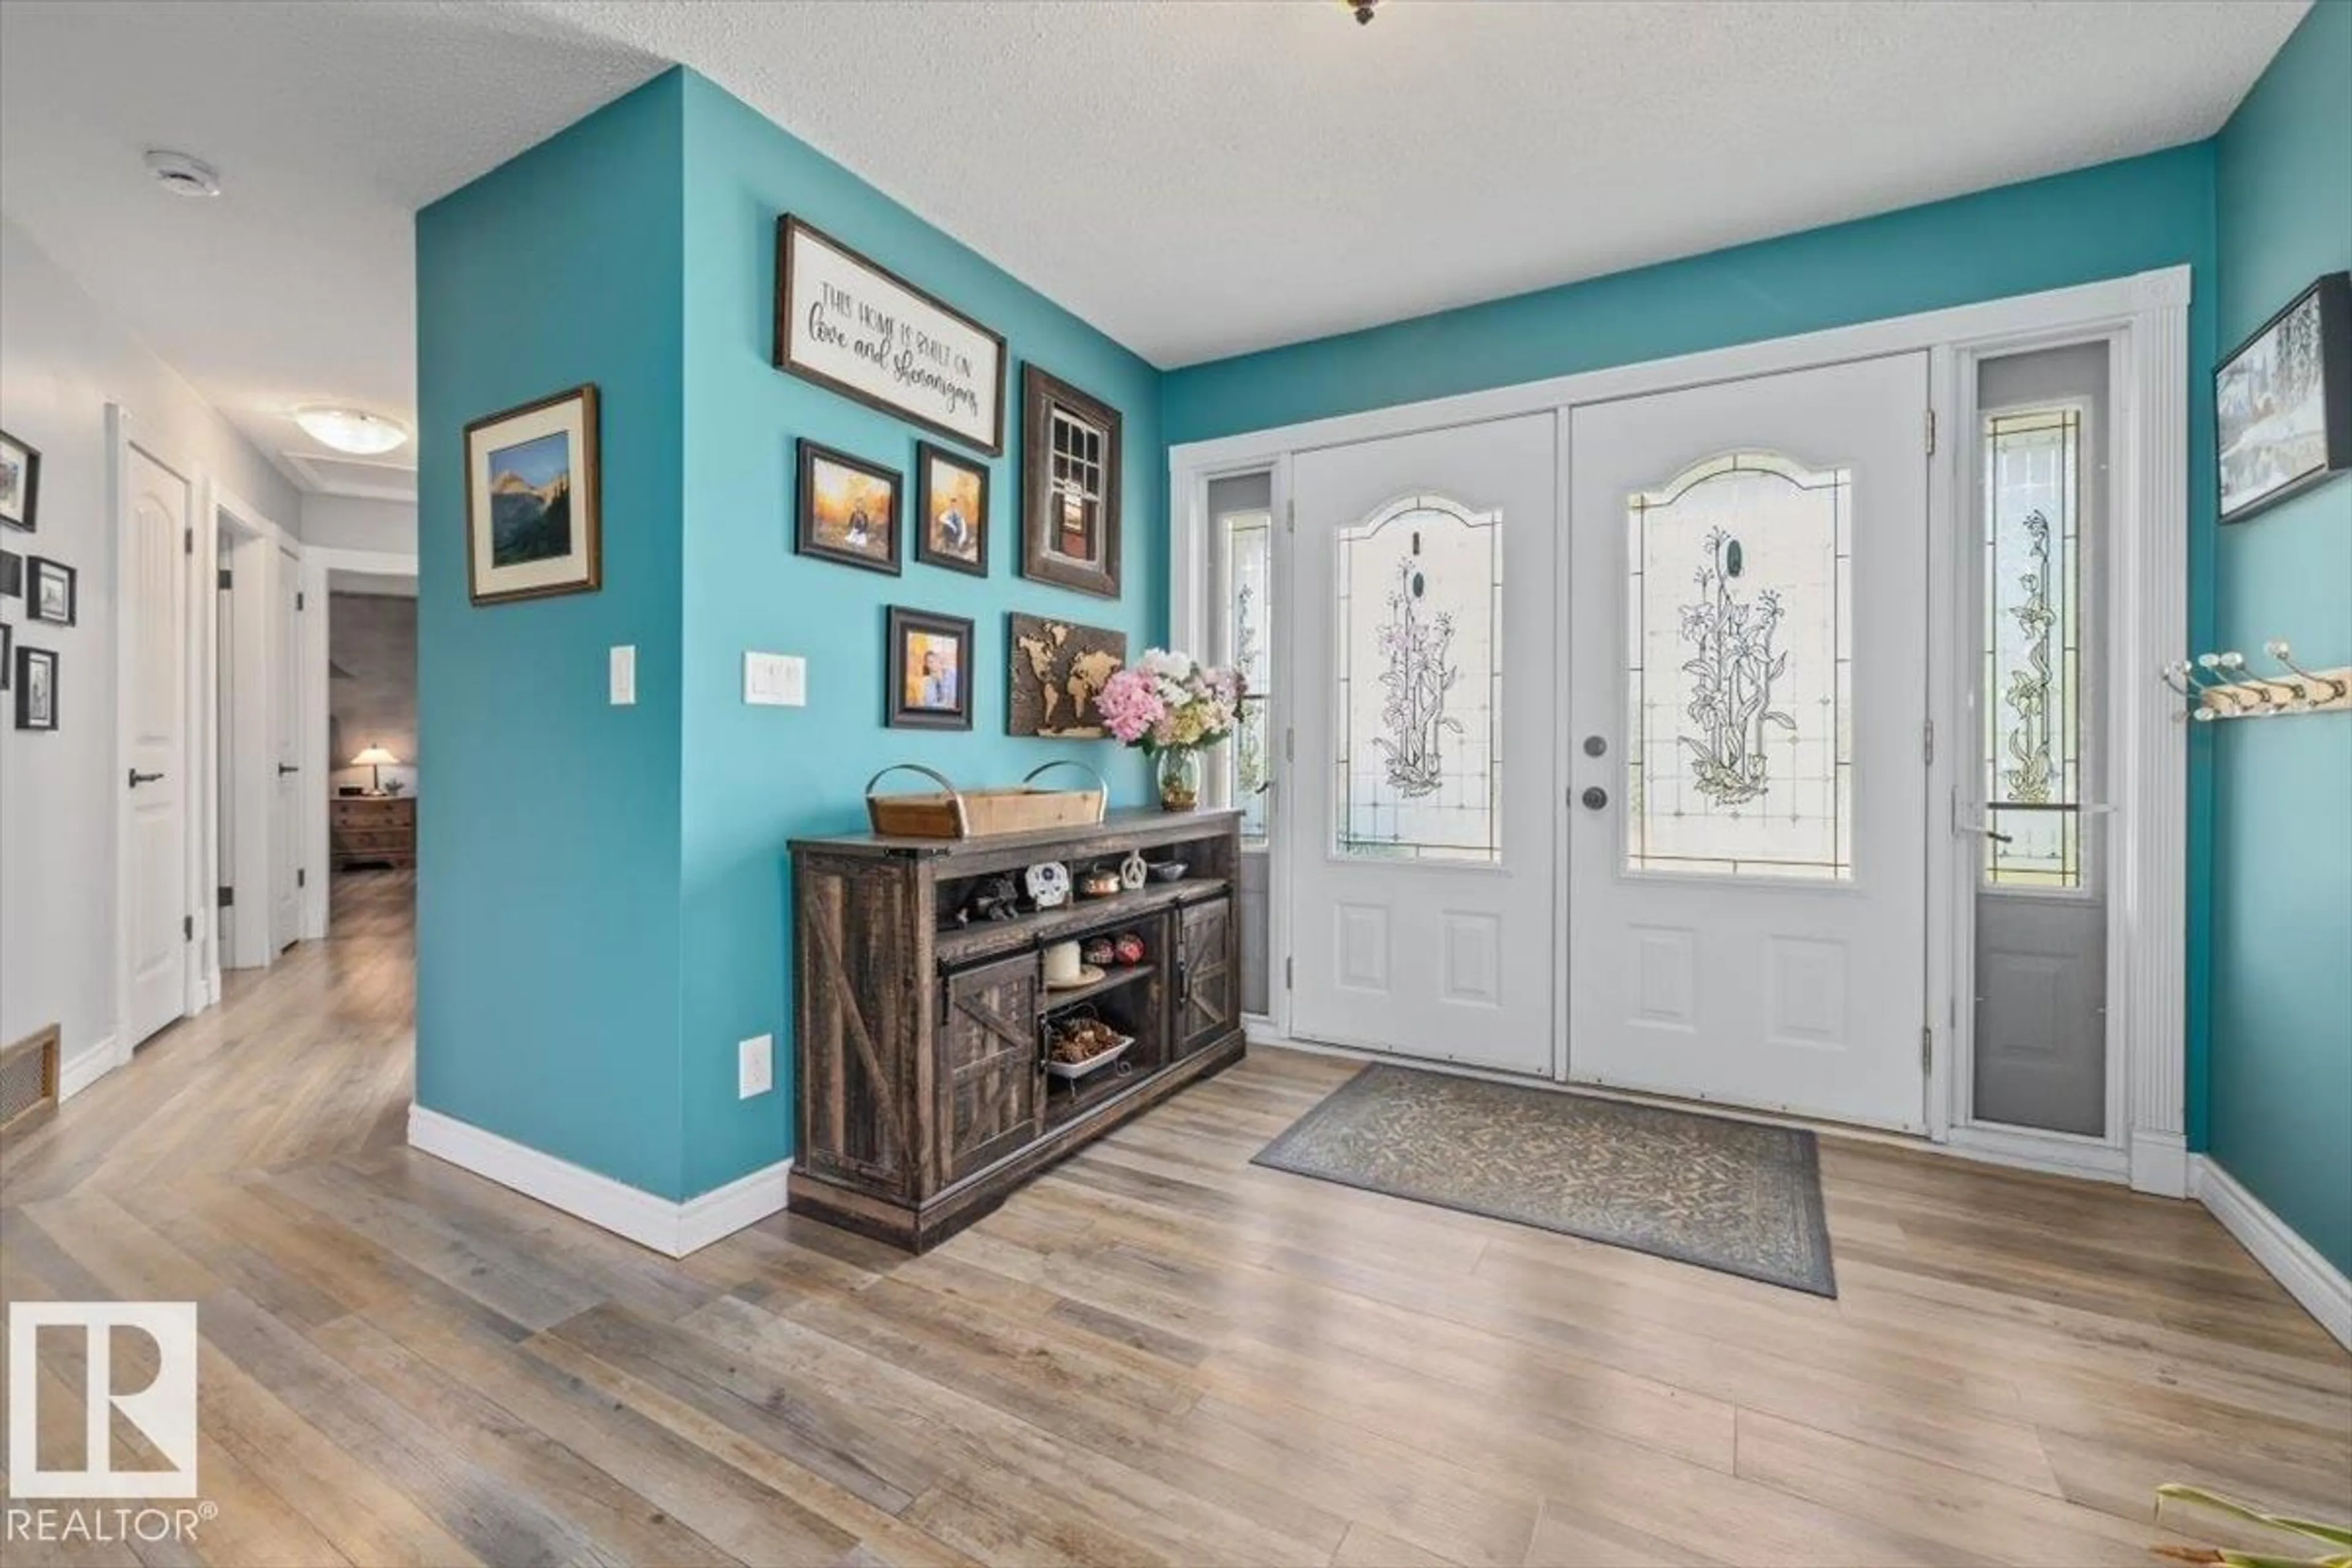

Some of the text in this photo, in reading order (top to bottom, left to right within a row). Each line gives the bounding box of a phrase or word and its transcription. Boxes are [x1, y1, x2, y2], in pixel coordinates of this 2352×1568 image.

[822, 282, 851, 318] THIS
[859, 302, 895, 340] HOME
[900, 323, 911, 345] IS
[854, 336, 892, 369] and
